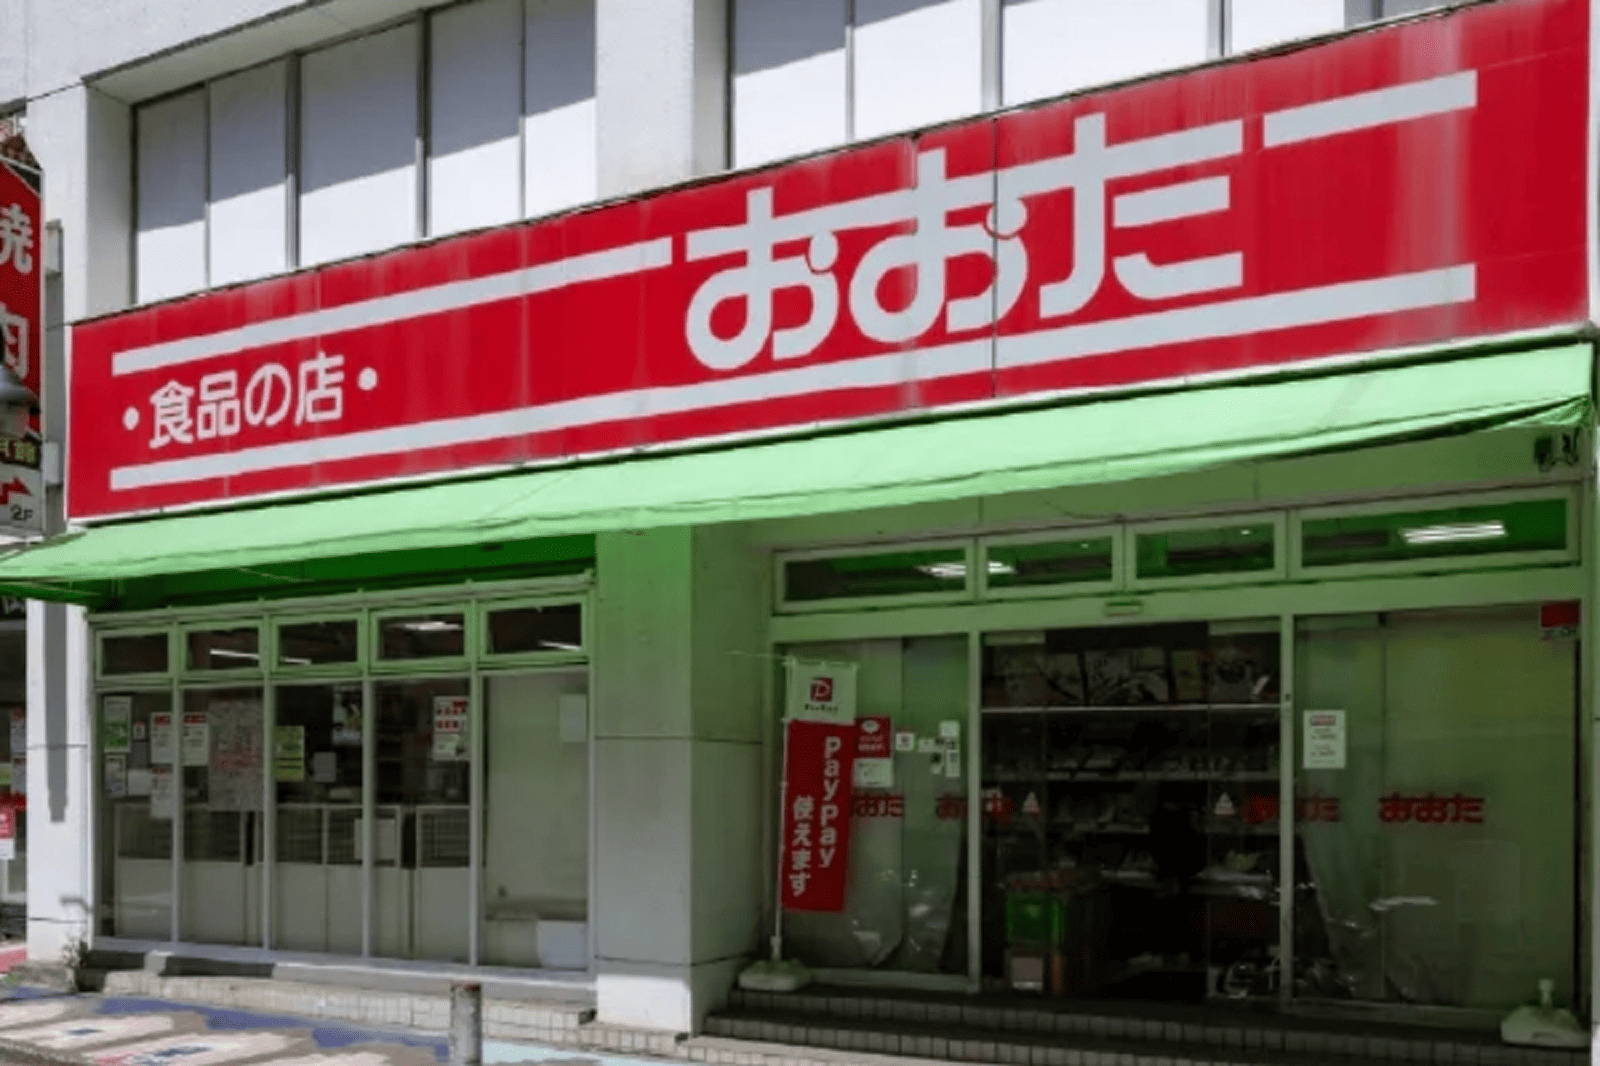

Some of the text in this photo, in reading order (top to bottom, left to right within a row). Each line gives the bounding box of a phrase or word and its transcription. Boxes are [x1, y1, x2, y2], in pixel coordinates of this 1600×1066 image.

[685, 113, 1243, 370] おおた
[149, 352, 344, 448] 食品の店
[10, 503, 34, 522] 2F
[788, 794, 815, 897] 使えます
[817, 735, 843, 869] PayPay
[1378, 792, 1486, 823] おおた
